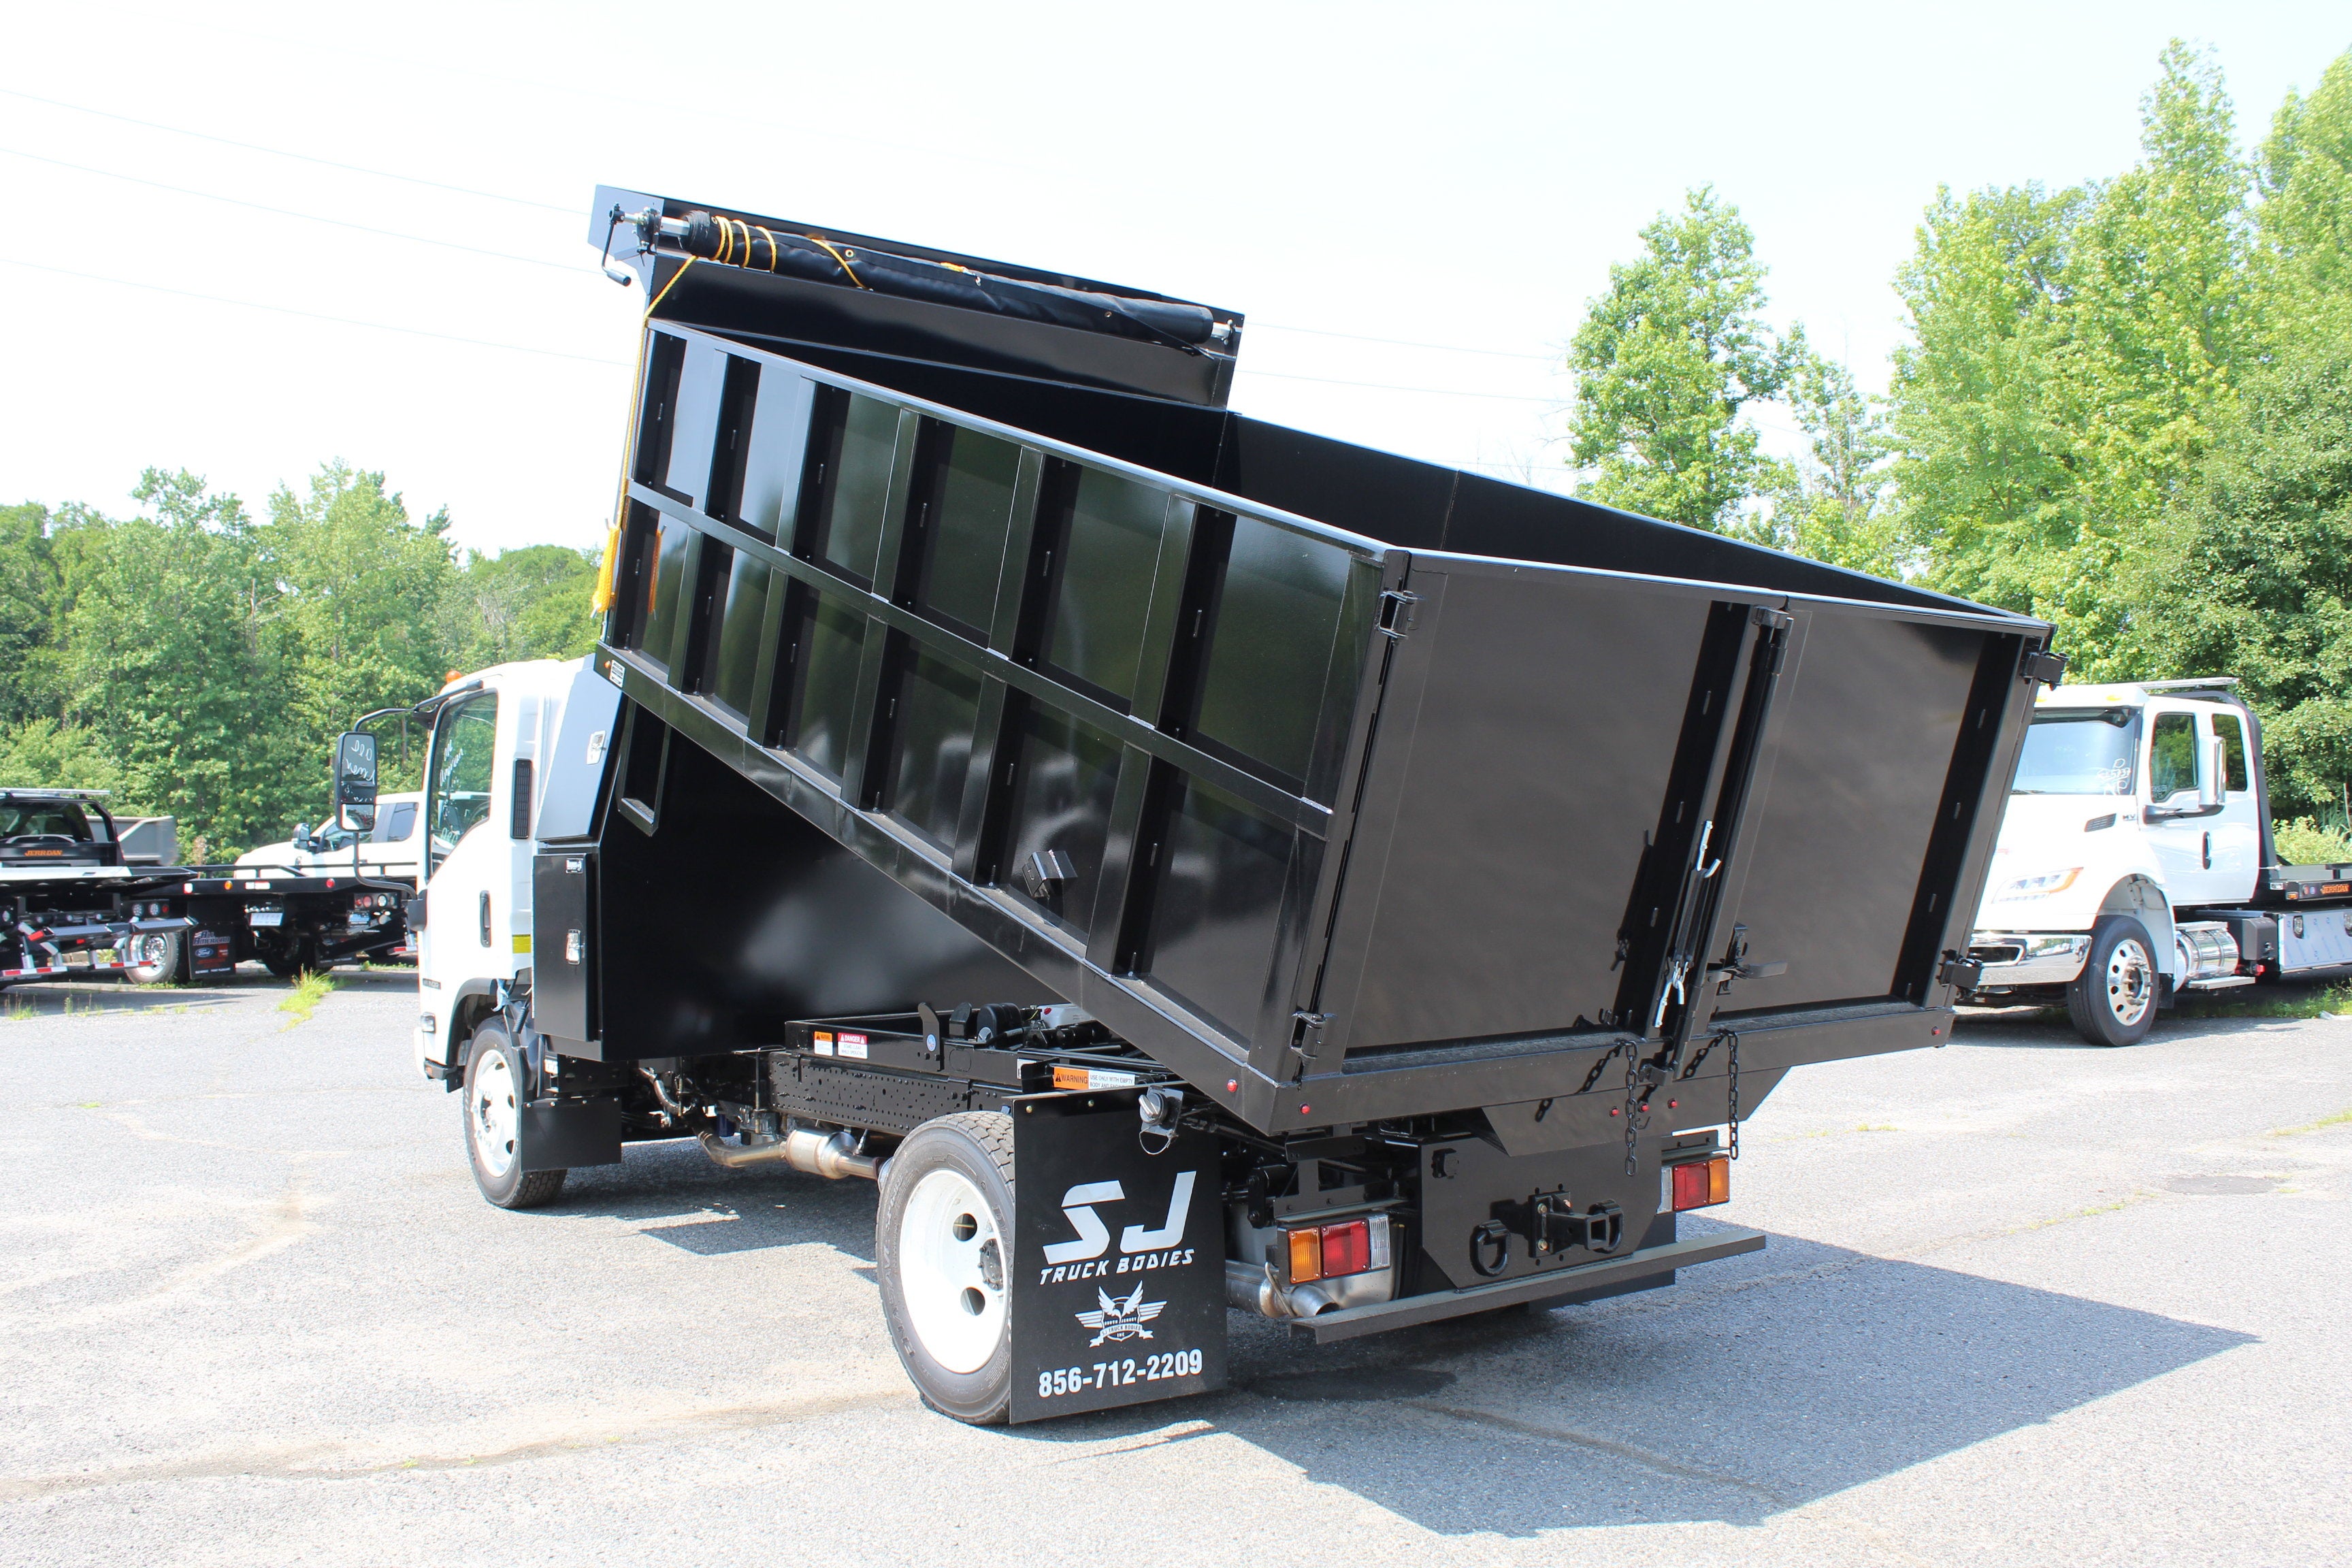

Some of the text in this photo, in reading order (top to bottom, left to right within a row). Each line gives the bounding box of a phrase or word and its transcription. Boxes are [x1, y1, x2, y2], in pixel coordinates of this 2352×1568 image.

[844, 1034, 860, 1043] DANGER
[1061, 1073, 1088, 1085] WARNING
[1043, 1171, 1196, 1265] SJ
[1040, 1248, 1194, 1286] TRUCK BODIES
[1039, 1349, 1203, 1398] 856-712-2209
